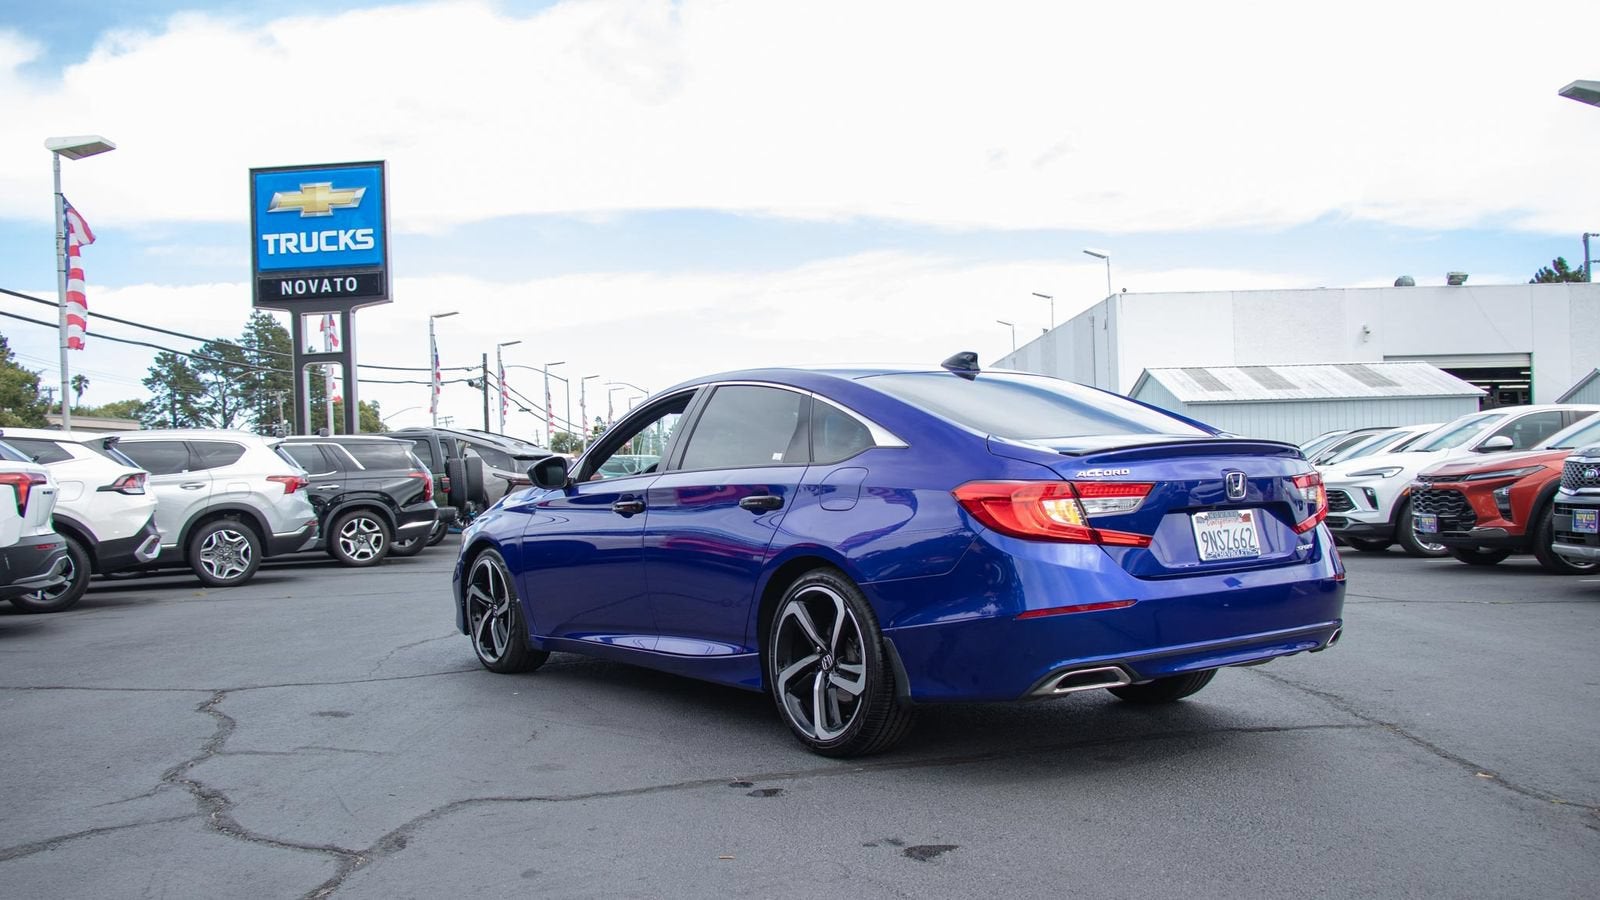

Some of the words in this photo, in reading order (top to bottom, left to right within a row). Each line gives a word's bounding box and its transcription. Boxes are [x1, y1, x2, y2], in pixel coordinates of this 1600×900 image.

[262, 228, 375, 255] TRUCKS
[281, 277, 358, 296] NOVATO
[1075, 468, 1130, 479] ACCORD
[1200, 528, 1255, 553] 9NSZ662
